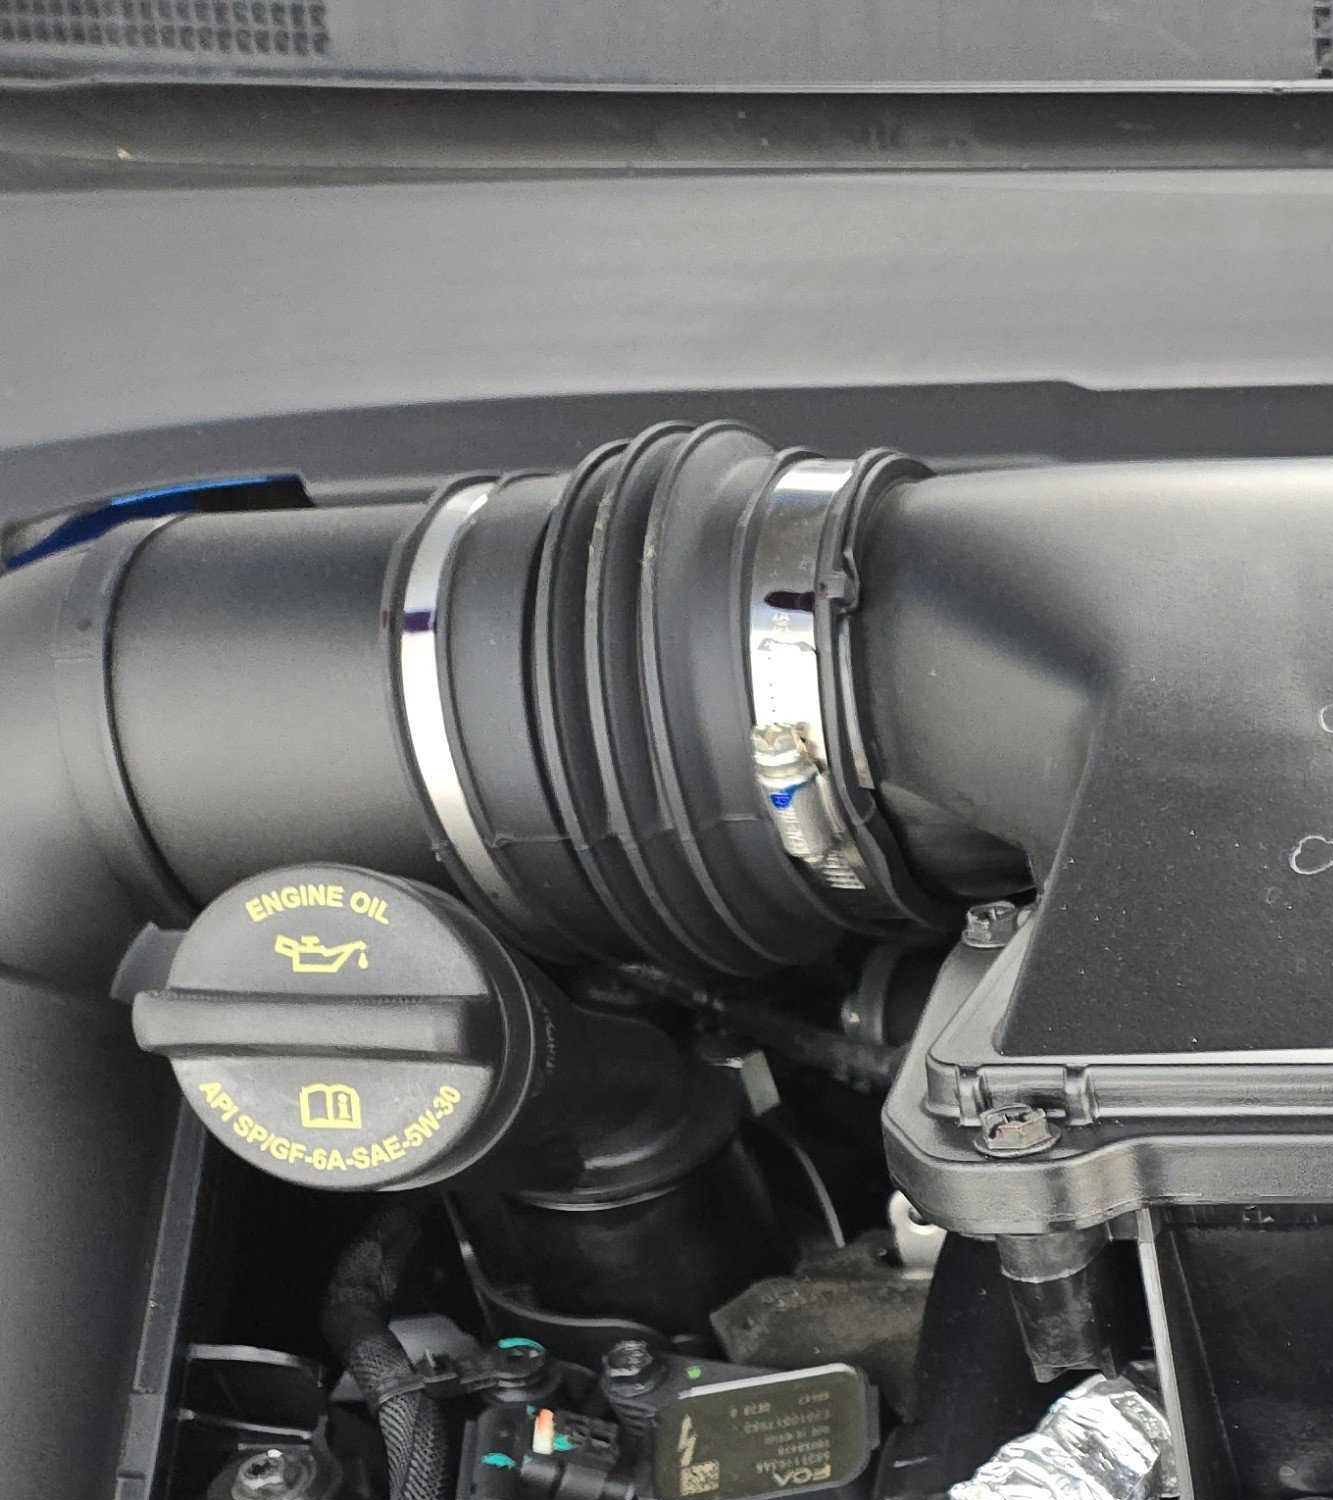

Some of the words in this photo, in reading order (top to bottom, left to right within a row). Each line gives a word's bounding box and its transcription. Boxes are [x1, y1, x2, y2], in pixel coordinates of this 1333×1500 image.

[246, 885, 344, 924] ENGINE
[347, 891, 392, 927] OIL
[198, 1080, 238, 1122] API
